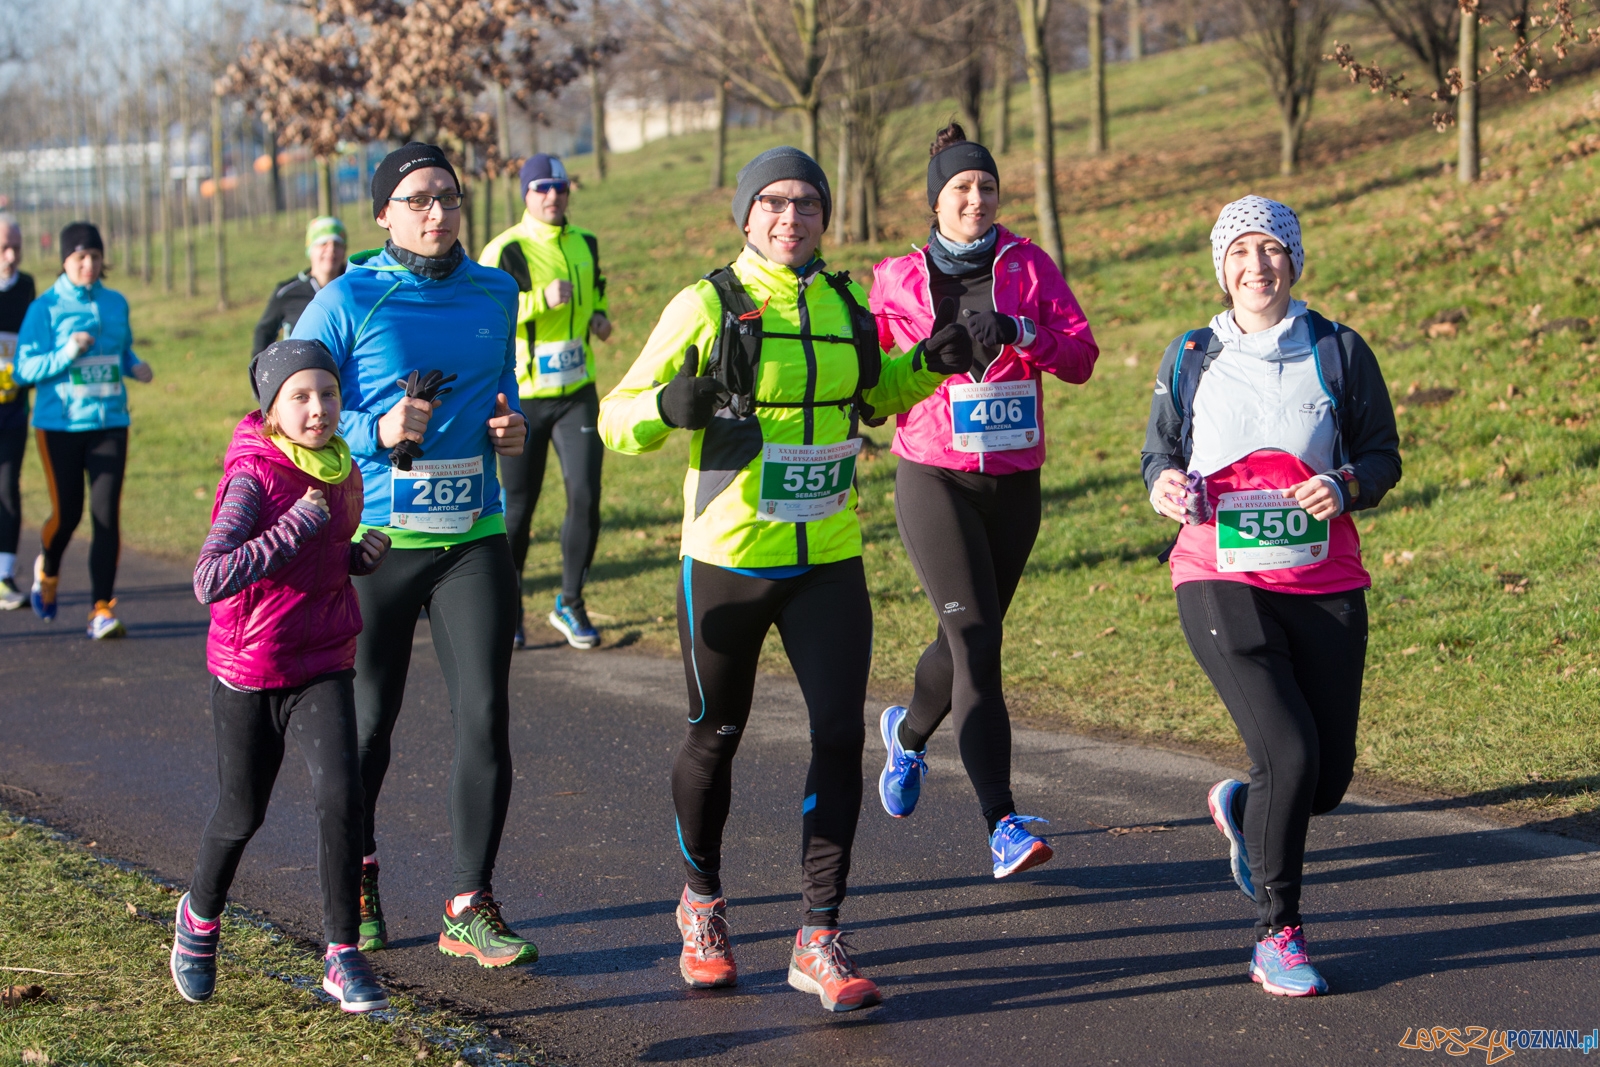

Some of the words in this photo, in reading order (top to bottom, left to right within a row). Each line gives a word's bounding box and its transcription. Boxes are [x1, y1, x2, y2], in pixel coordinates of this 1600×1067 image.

[969, 398, 1023, 425] 406
[984, 423, 1012, 431] MARZENA
[782, 461, 842, 492] 551
[411, 477, 472, 506] 262
[795, 489, 832, 499] SEBASTIAN
[1237, 509, 1309, 540] 550
[1258, 538, 1290, 546] DOROTA
